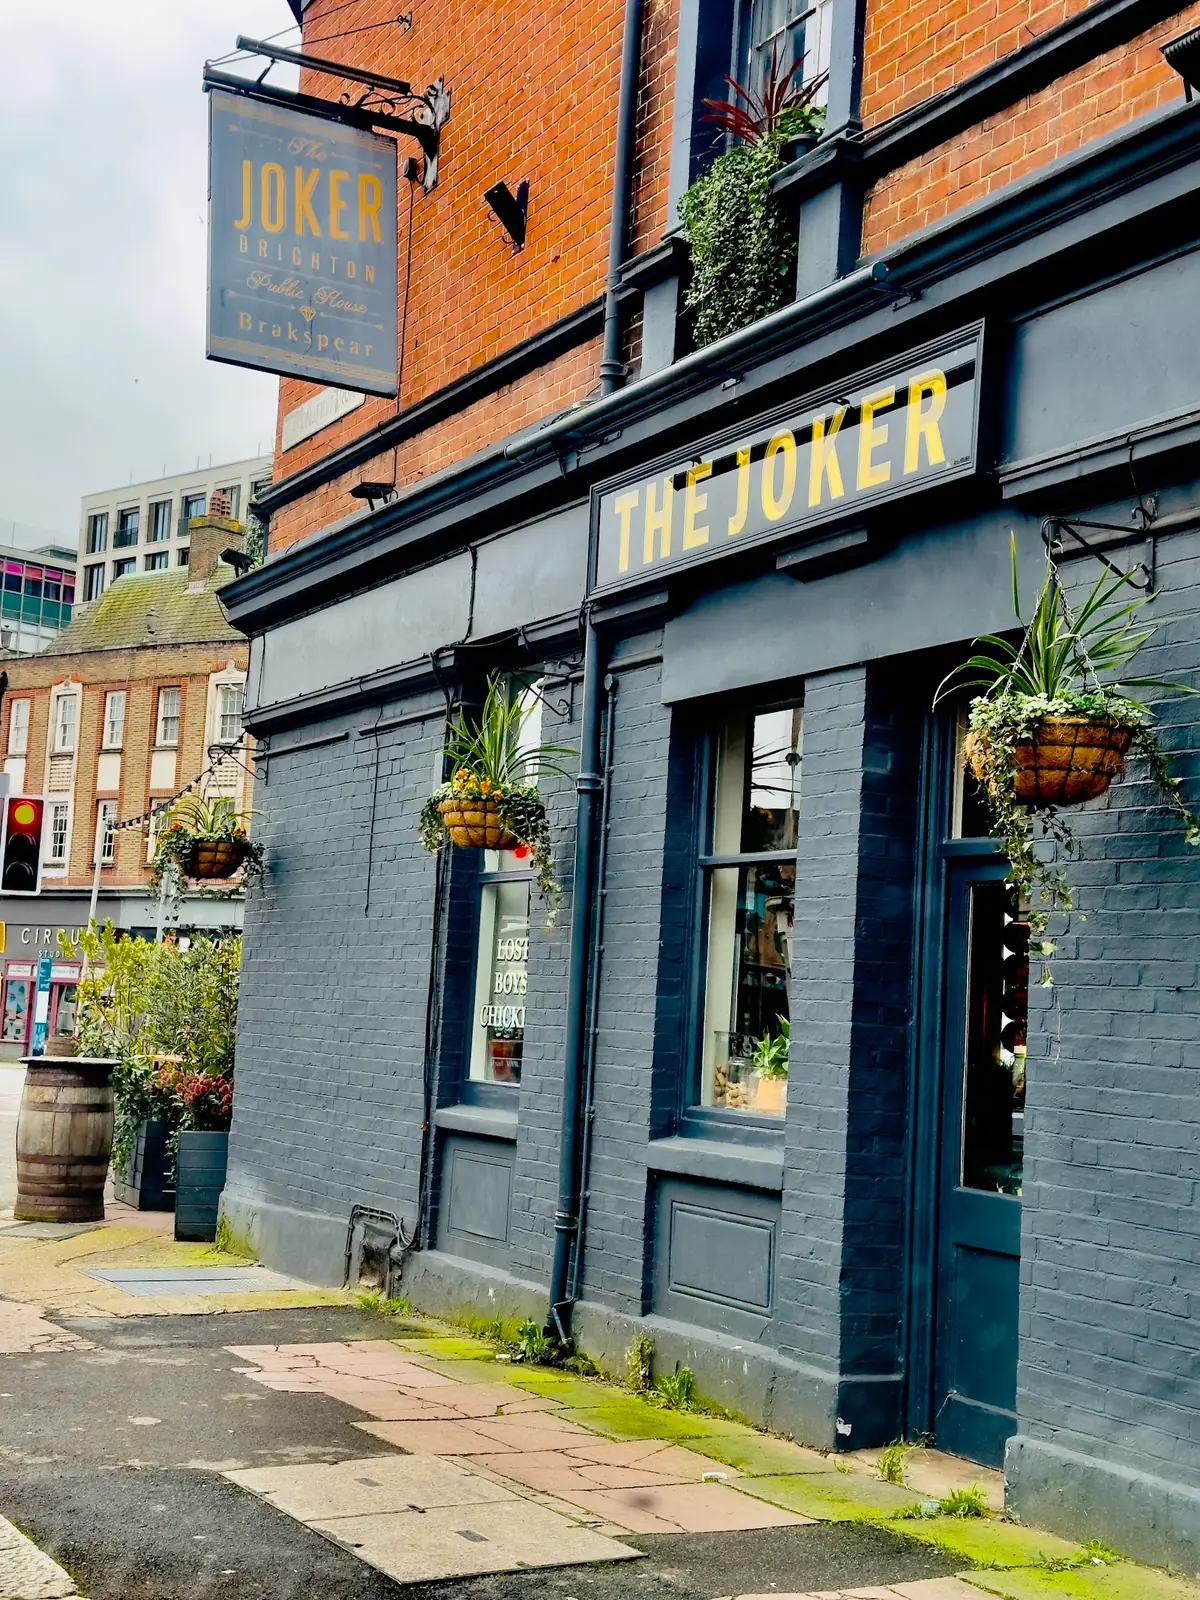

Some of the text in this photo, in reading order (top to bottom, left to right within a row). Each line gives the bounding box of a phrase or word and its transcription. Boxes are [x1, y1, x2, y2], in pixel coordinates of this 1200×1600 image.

[288, 136, 327, 160] The
[234, 160, 383, 243] JOKER
[239, 234, 376, 284] BRIGHTON
[246, 270, 367, 314] Public House
[238, 311, 373, 357] Brakspear
[614, 368, 948, 573] THE JOKER
[21, 927, 80, 946] CIRCU
[496, 938, 529, 961] LOST
[38, 949, 64, 959] STUDI
[494, 971, 528, 994] BOYS
